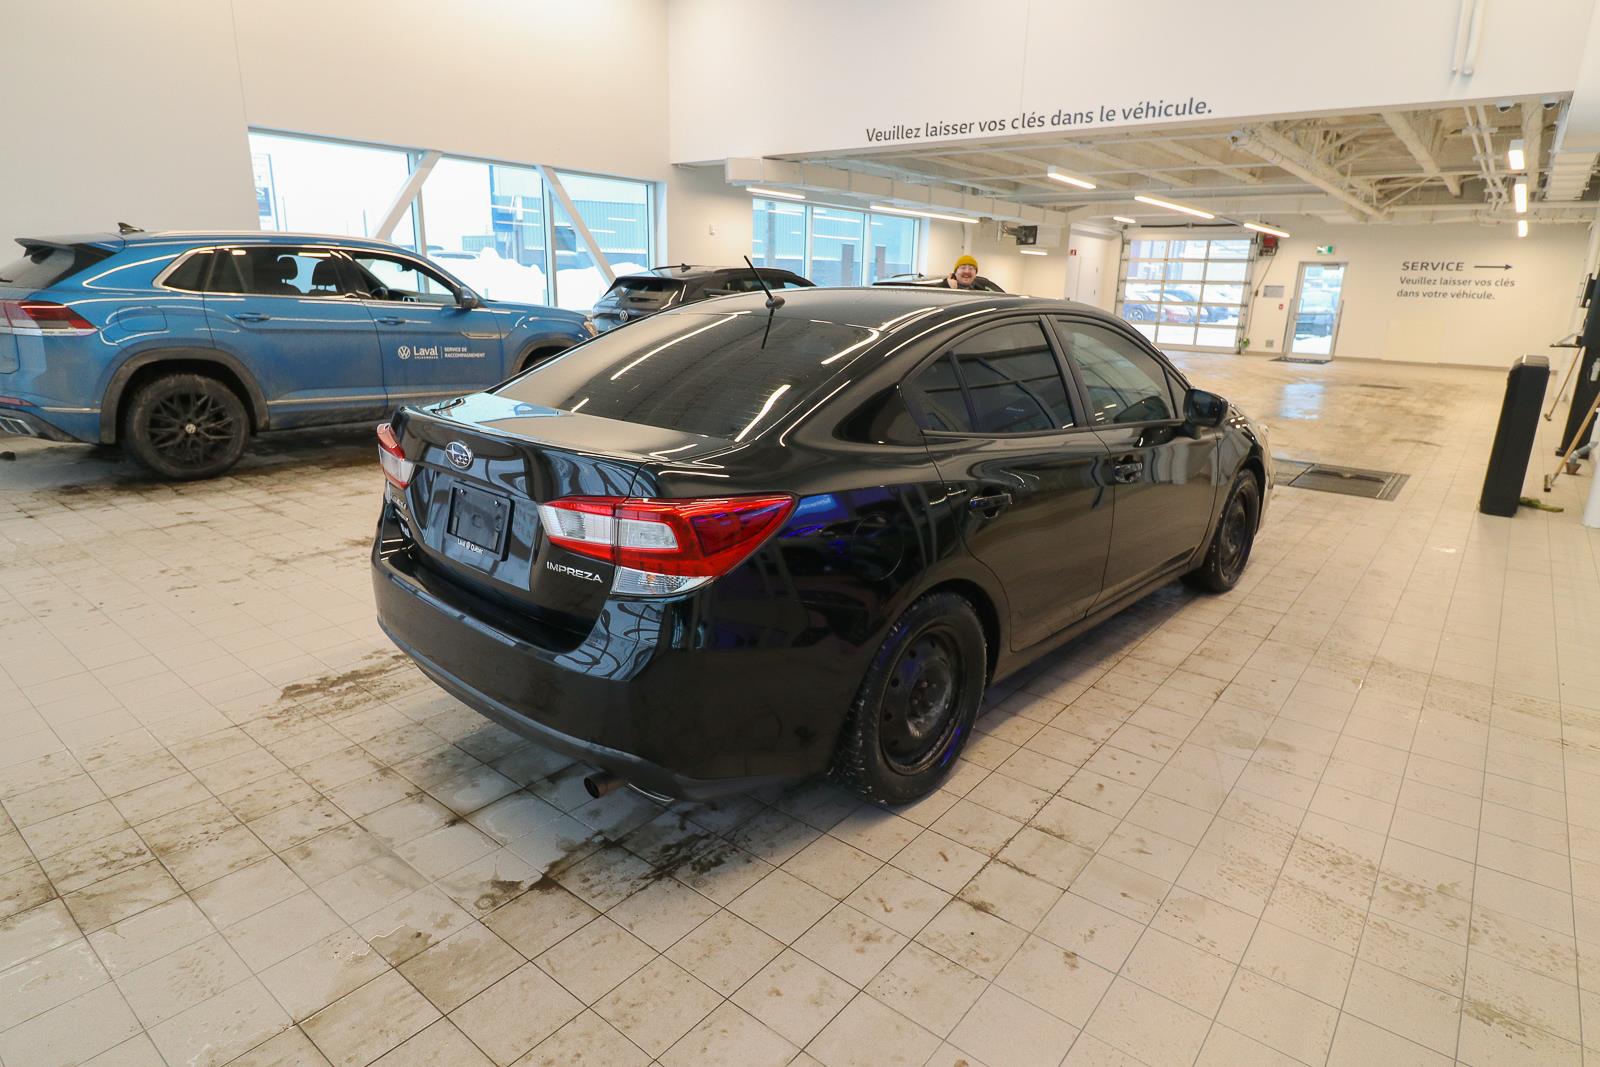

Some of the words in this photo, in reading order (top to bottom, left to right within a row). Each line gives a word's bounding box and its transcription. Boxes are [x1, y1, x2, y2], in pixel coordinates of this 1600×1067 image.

[866, 125, 921, 142] Veuillez
[925, 120, 975, 137] laisser
[978, 119, 1006, 132] vos
[1011, 112, 1045, 129] clés
[1050, 109, 1094, 126] dans
[1099, 106, 1116, 122] le
[1122, 97, 1213, 120] véhicule.
[1401, 261, 1464, 271] SERVICE
[1400, 276, 1437, 286] Veuillez
[1440, 276, 1471, 287] laisser
[1474, 278, 1492, 287] vos
[1495, 277, 1515, 288] clés
[1396, 288, 1420, 298] dans
[1422, 289, 1448, 299] votre
[1450, 289, 1495, 300] véhicule.
[413, 345, 438, 356] Laval
[546, 561, 603, 583] IMPREZA
